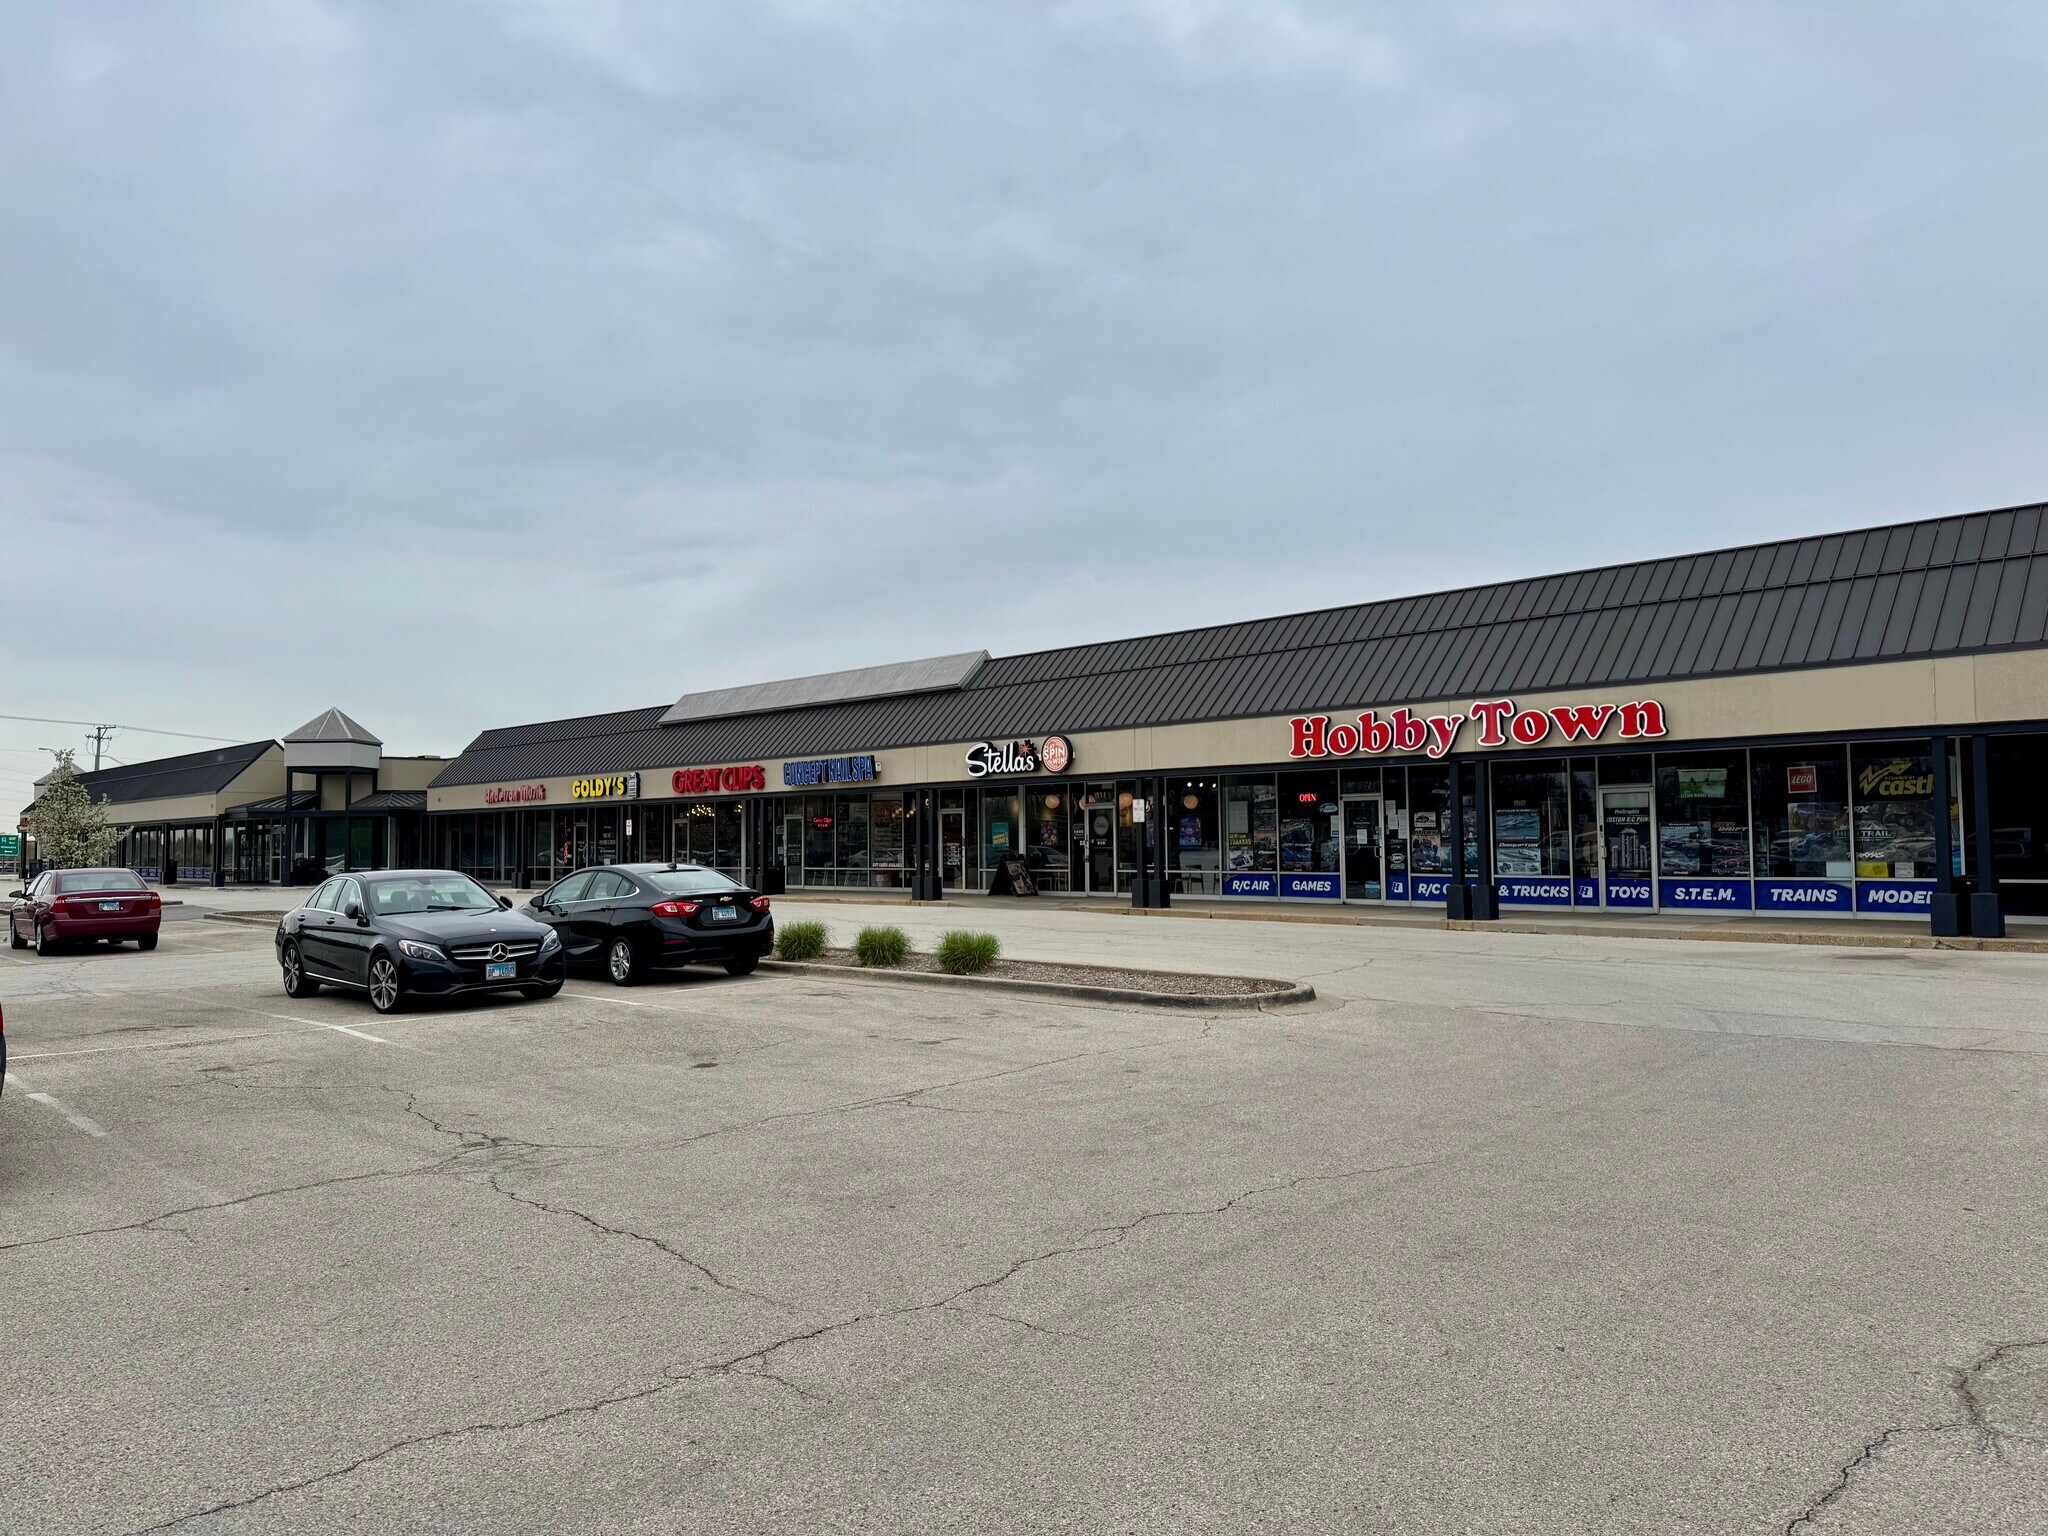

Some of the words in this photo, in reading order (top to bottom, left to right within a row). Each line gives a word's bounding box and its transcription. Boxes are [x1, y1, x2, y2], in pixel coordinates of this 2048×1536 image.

[1289, 708, 1464, 758] Hobby
[1470, 699, 1667, 747] Town
[1043, 746, 1065, 760] SPIN
[783, 759, 829, 787] CONCEPT
[829, 757, 852, 784] NAIL
[852, 755, 876, 782] SPA
[672, 768, 722, 793] GREAT
[722, 765, 765, 790] CLIPS
[1791, 775, 1812, 785] LEGO
[1879, 774, 1934, 796] castl
[572, 777, 625, 798] GOLDY'S
[1300, 794, 1316, 802] OPEN
[1232, 880, 1251, 893] R/C
[1251, 880, 1270, 891] AIR
[1292, 880, 1332, 892] GAMES
[1418, 883, 1441, 897] R/C
[1498, 885, 1509, 897] &
[1512, 885, 1569, 898] TRUCKS
[1609, 886, 1650, 899] TOYS
[1674, 887, 1736, 901] S.T.E.M.
[1770, 888, 1838, 902] TRAINS
